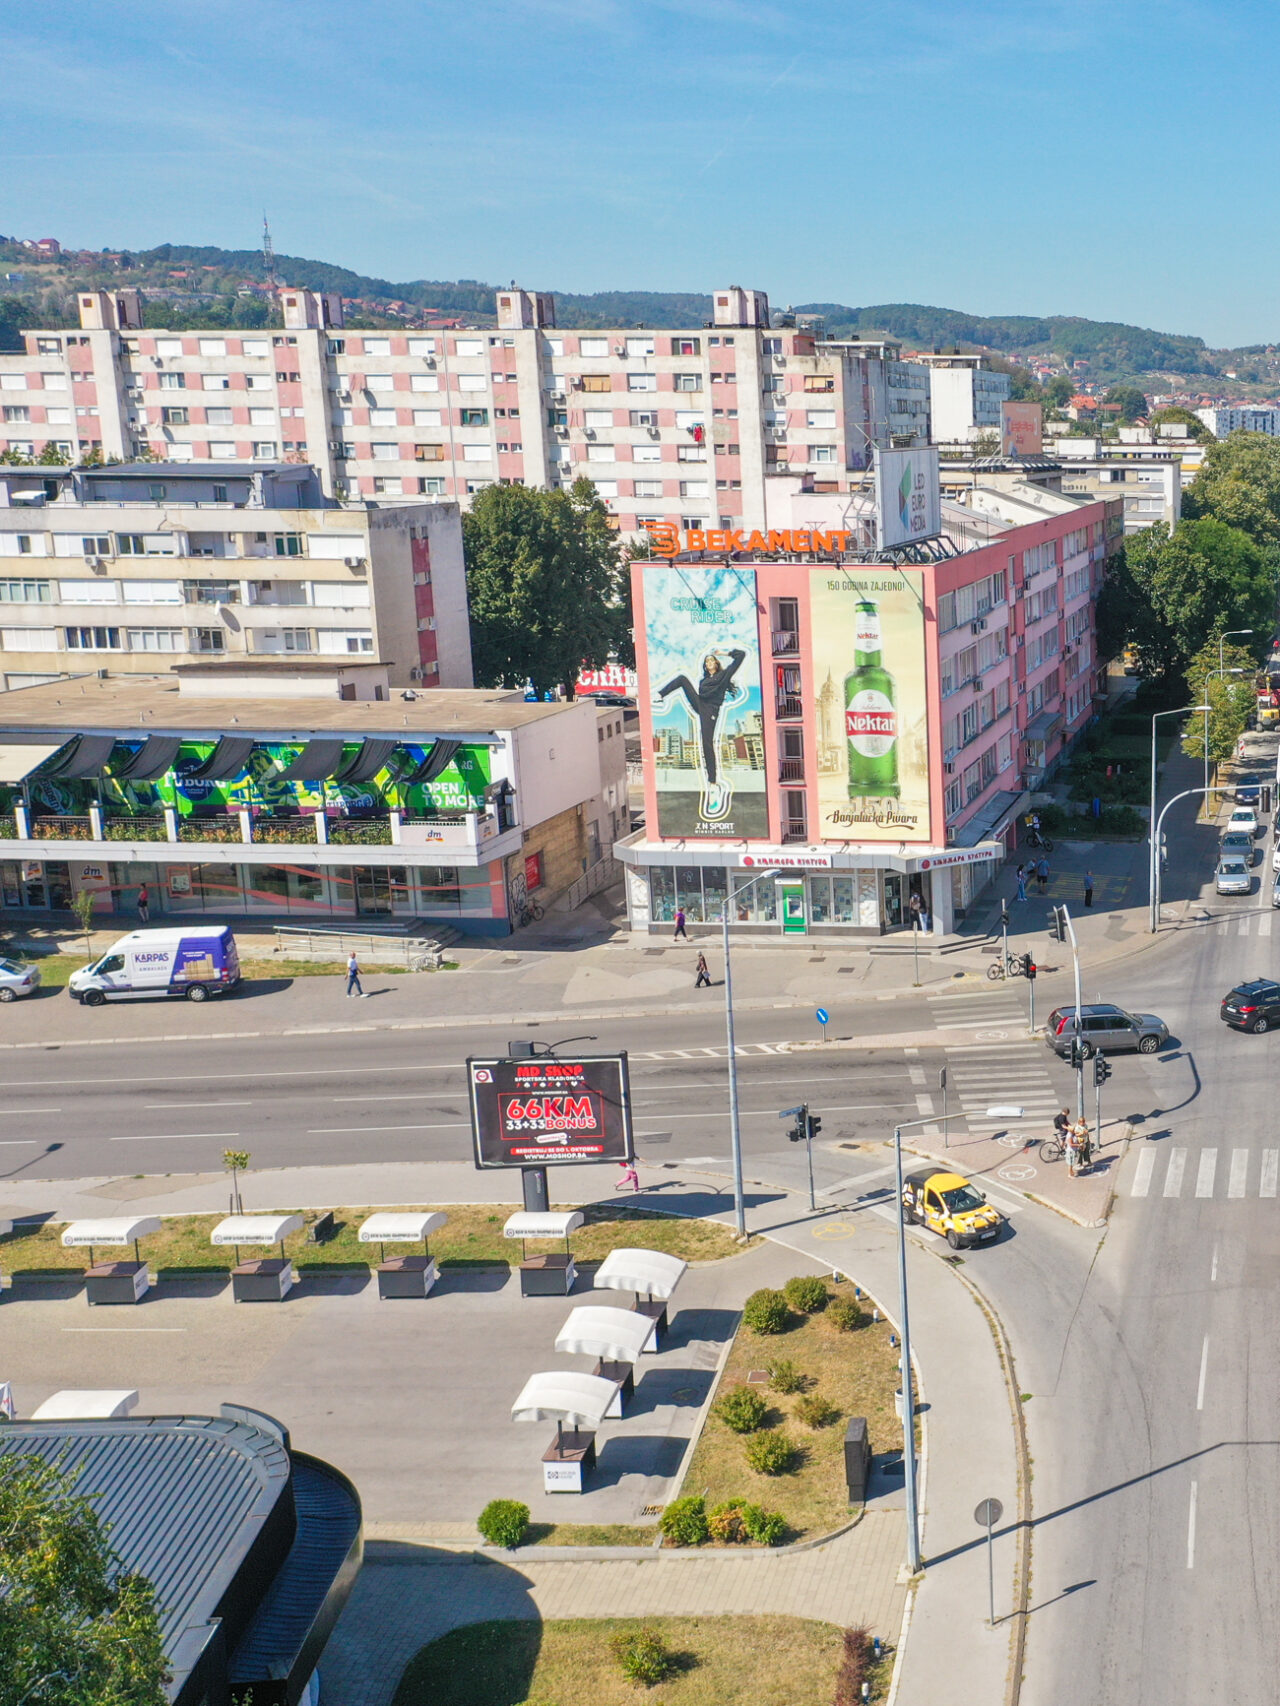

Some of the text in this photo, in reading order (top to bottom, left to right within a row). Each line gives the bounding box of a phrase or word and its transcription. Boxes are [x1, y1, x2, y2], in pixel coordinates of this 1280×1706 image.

[687, 529, 850, 551] BEKAMENT
[827, 581, 905, 591] 150 GODINA ZAJEDNO!
[670, 597, 721, 611] CRUISE
[690, 610, 734, 623] RIDER
[846, 714, 896, 732] Nektar
[421, 782, 459, 794] OPEN
[421, 795, 484, 807] TO MORE
[886, 811, 918, 824] Pivara
[710, 822, 735, 830] SPORT
[427, 829, 442, 838] dm
[83, 865, 100, 875] dm
[135, 953, 169, 963] KARPAS
[517, 1065, 583, 1077] MD SHOP
[506, 1095, 593, 1120] 66KM
[524, 1152, 587, 1160] WWW.MDSHOP.BA
